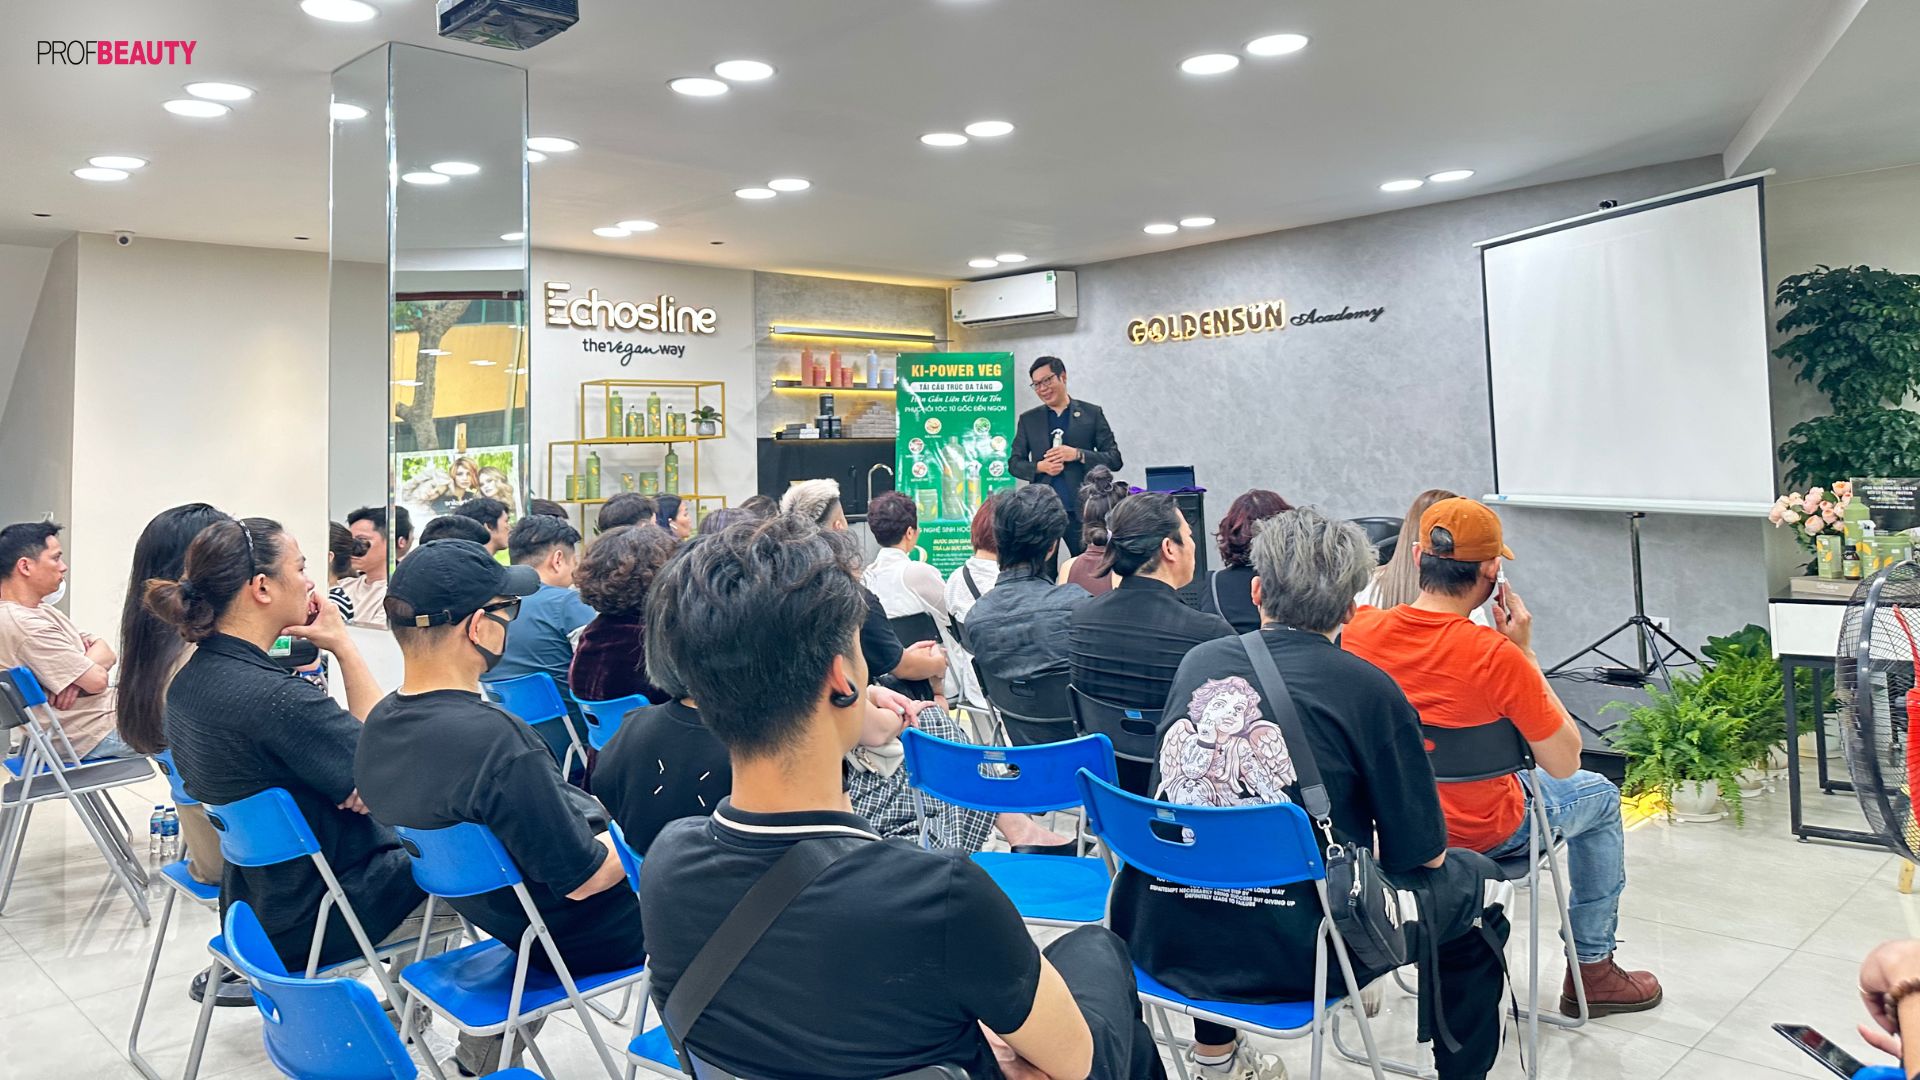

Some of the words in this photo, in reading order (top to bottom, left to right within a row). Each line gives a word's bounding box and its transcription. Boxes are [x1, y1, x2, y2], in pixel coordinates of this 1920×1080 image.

[544, 281, 717, 334] Echosline
[1290, 305, 1385, 326] Academy
[911, 364, 974, 377] KI-POWER
[978, 364, 1002, 376] VEG
